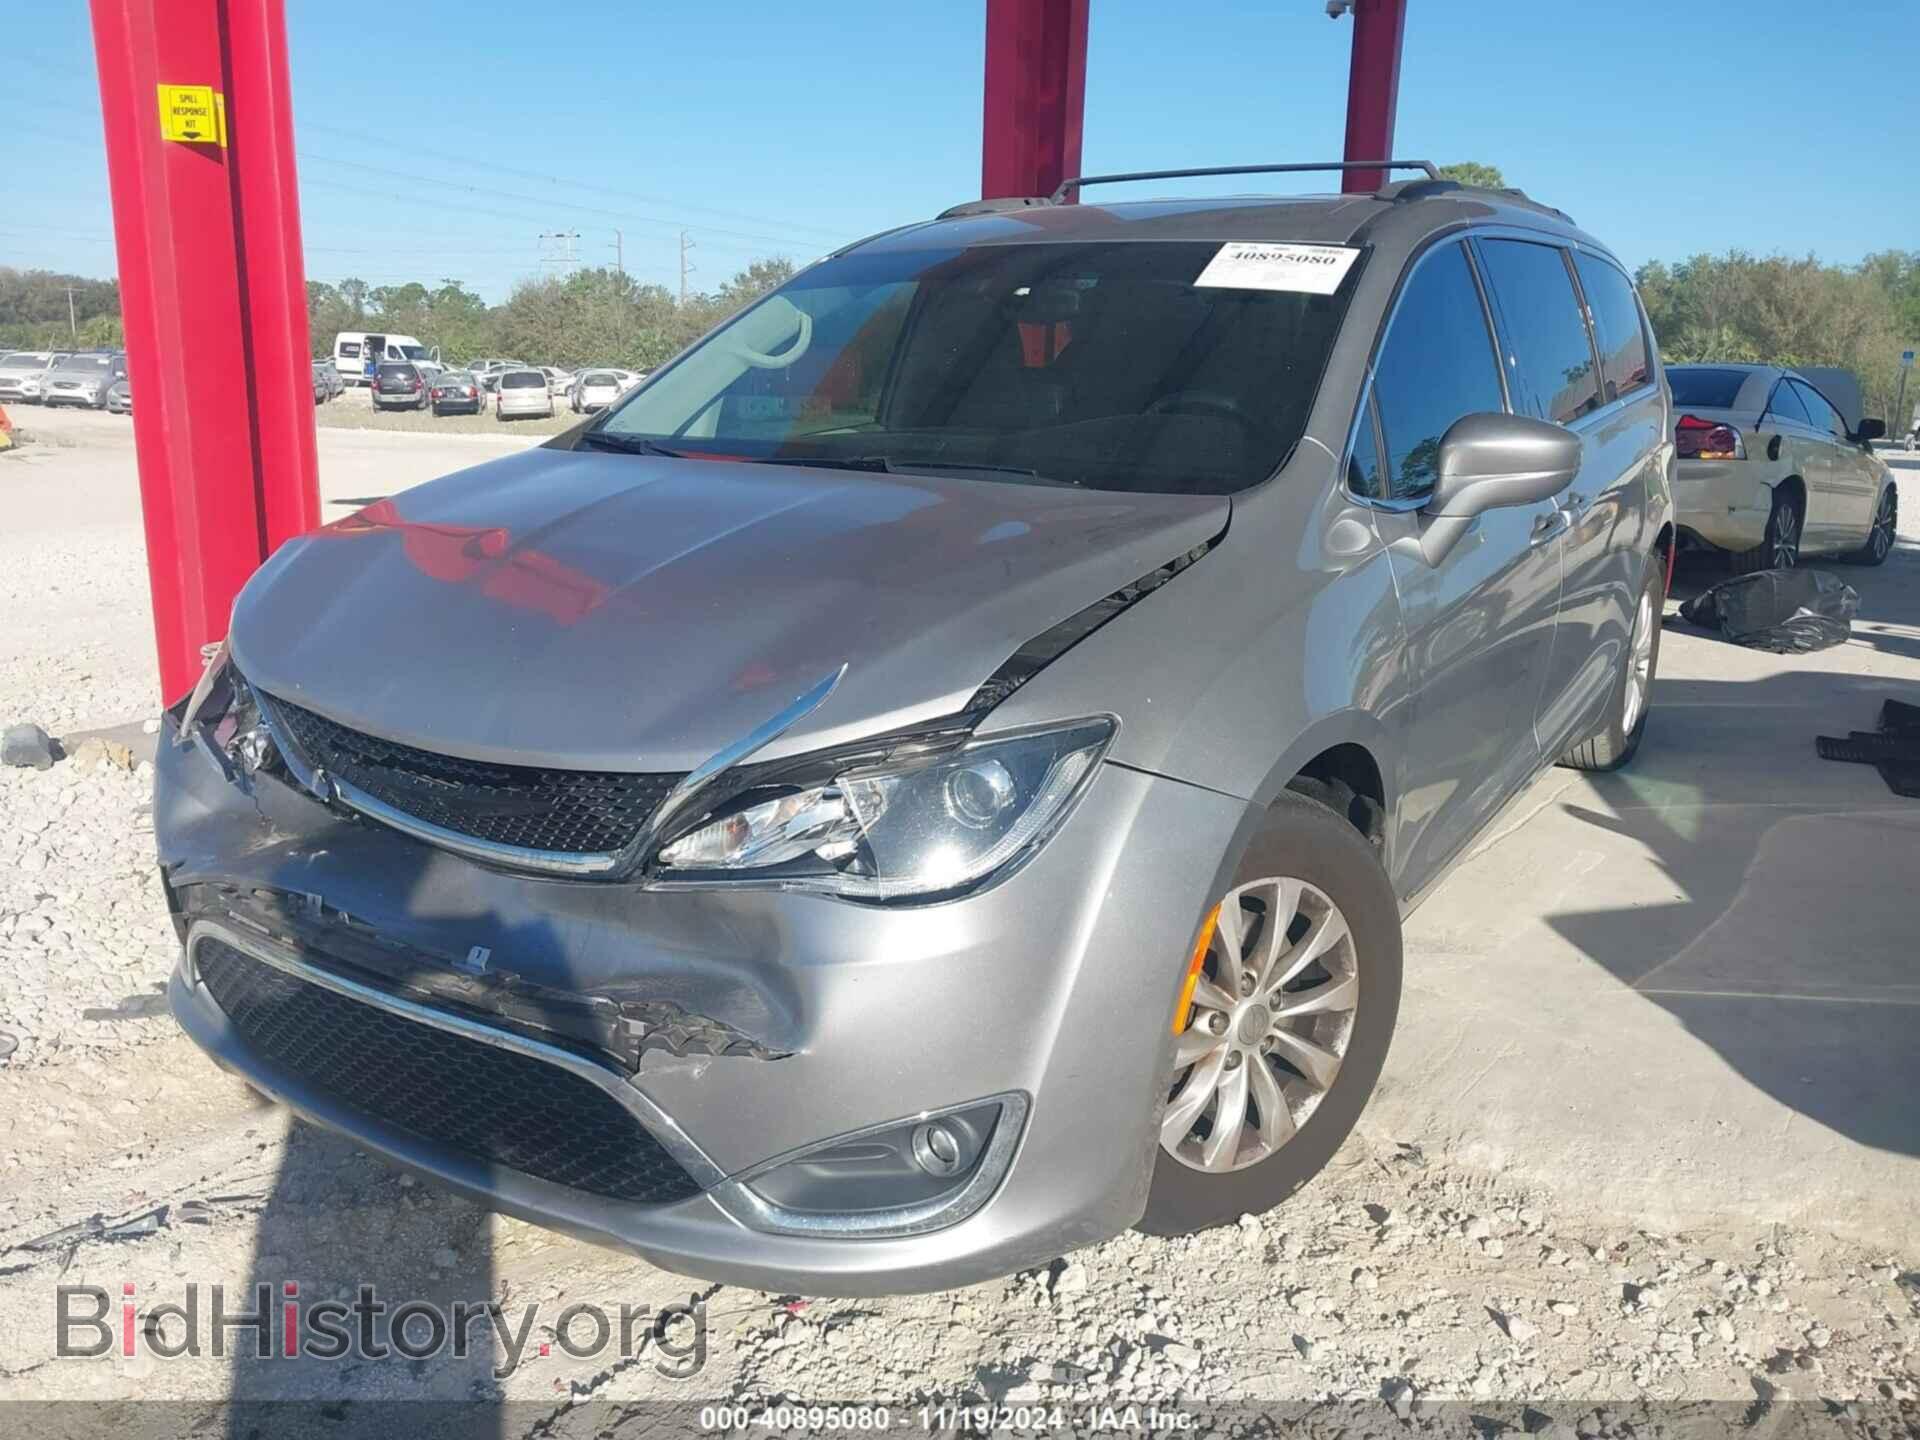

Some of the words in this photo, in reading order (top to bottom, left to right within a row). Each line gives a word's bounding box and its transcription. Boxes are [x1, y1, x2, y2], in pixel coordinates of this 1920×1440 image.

[179, 94, 198, 104] SPILL
[173, 106, 208, 116] RESPONSE
[185, 119, 196, 128] KIT
[1231, 252, 1337, 265] 40895080
